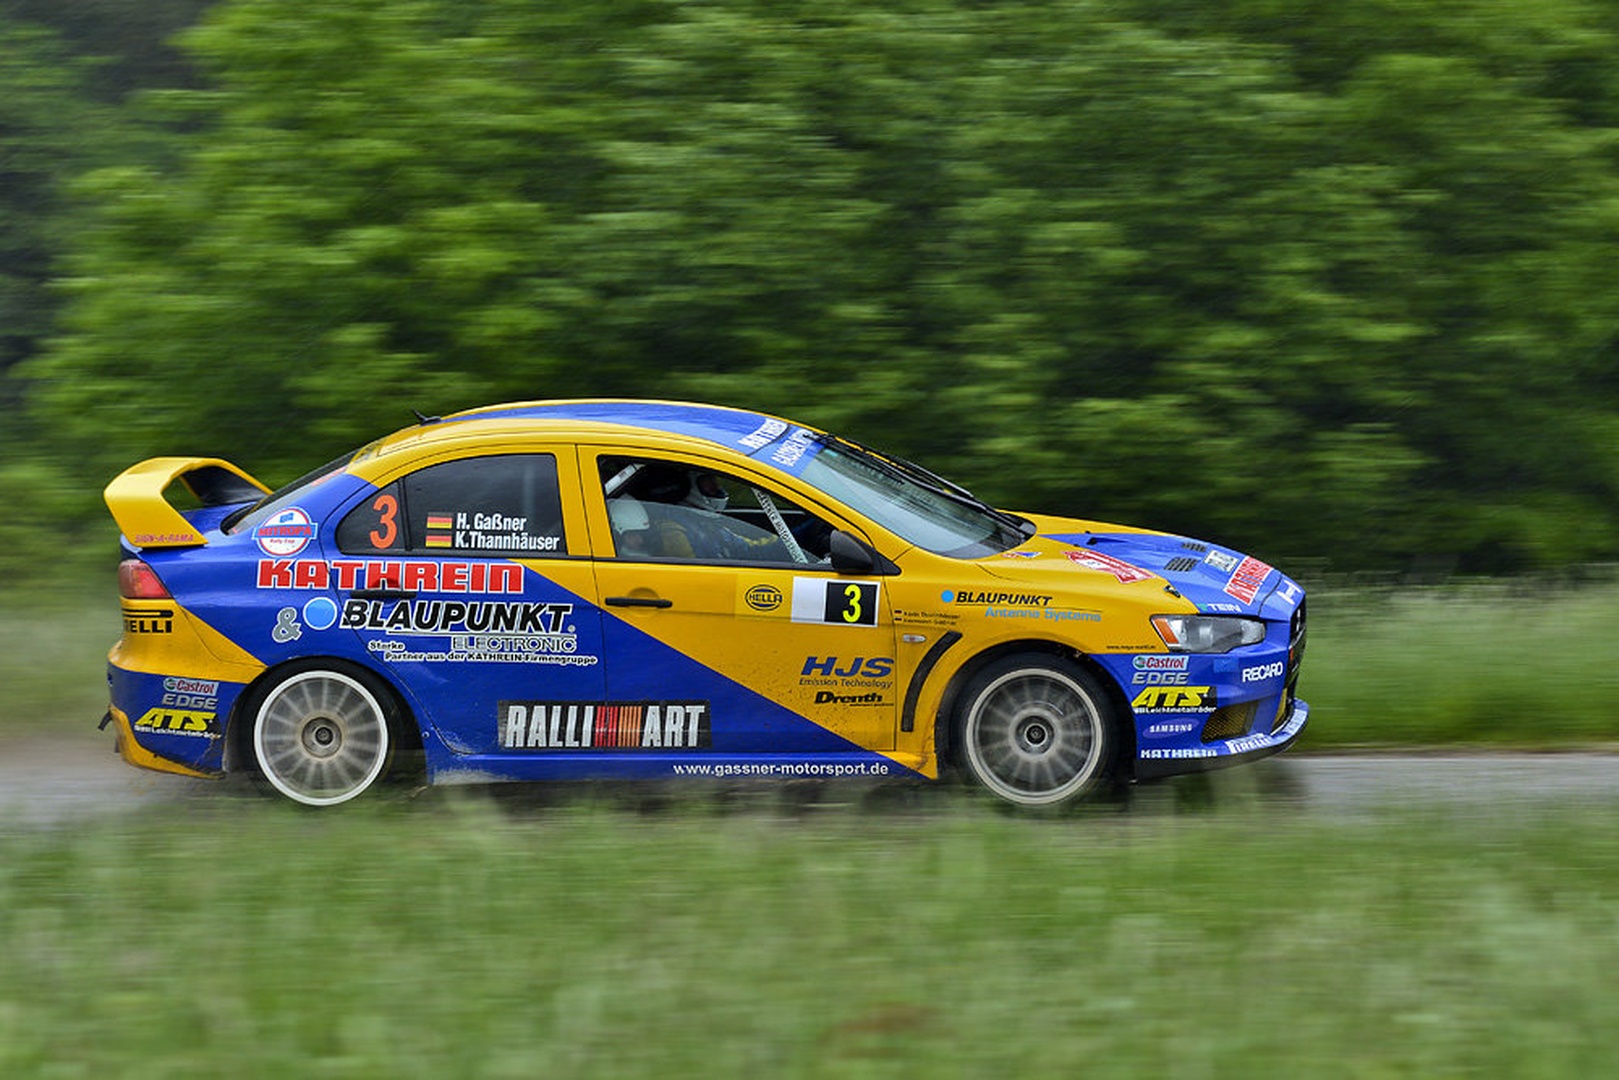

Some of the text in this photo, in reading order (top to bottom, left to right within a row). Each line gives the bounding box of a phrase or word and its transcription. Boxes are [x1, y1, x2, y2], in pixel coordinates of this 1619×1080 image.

[369, 494, 398, 549] 3
[456, 512, 527, 532] H. Gaßner
[258, 525, 312, 537] MITROPA
[257, 558, 524, 595] KATHREIN
[749, 593, 783, 603] HELLA
[842, 583, 862, 623] 3
[955, 591, 1053, 607] BLAUPUNKT
[272, 599, 573, 643] & BLAUPUNKT
[985, 606, 1102, 623] Antenna Systems
[452, 636, 577, 653] ELECTRONIC
[384, 651, 424, 662] Partner
[426, 653, 446, 662] aus
[447, 652, 465, 662] der
[1145, 657, 1185, 669] Castrol
[801, 656, 895, 678] HJS
[1242, 661, 1284, 683] RECARO
[799, 677, 893, 690] Emission Technology
[1131, 672, 1191, 685] EDGE
[175, 680, 215, 695] Castrol
[161, 693, 219, 710] EDGE
[814, 690, 883, 705] Drenth
[1131, 686, 1210, 708] ATS
[135, 707, 217, 732] ATS
[1149, 723, 1193, 734] SAMSUNG
[672, 762, 890, 778] www.gassner-motorsport.de
